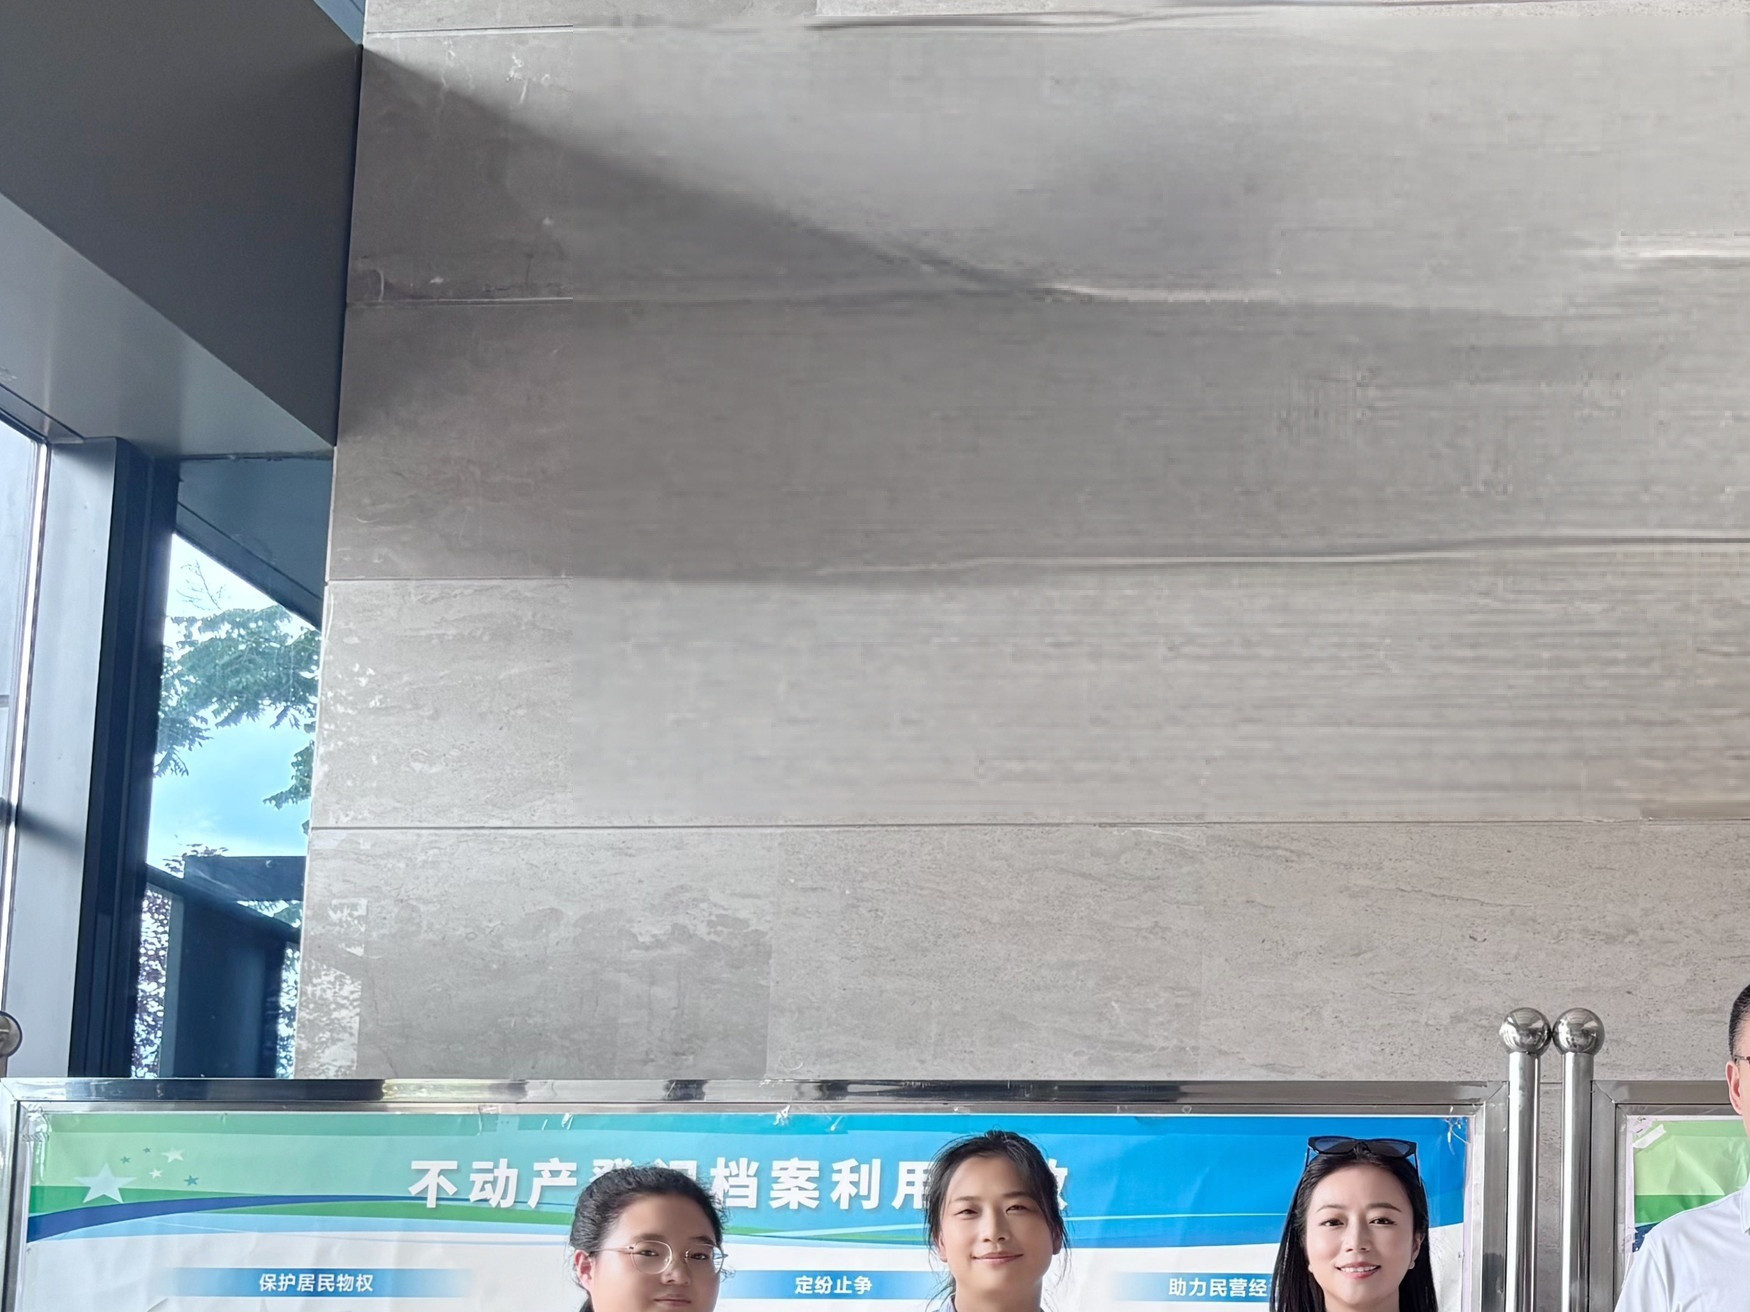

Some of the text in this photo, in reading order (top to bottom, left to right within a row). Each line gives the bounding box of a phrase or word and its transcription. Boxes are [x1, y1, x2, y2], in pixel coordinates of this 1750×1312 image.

[408, 1157, 1069, 1210] 不动产档案利用
[260, 1274, 374, 1292] 保护居民物权
[794, 1275, 873, 1295] 定纷止争
[1168, 1277, 1268, 1297] 助力民营经
